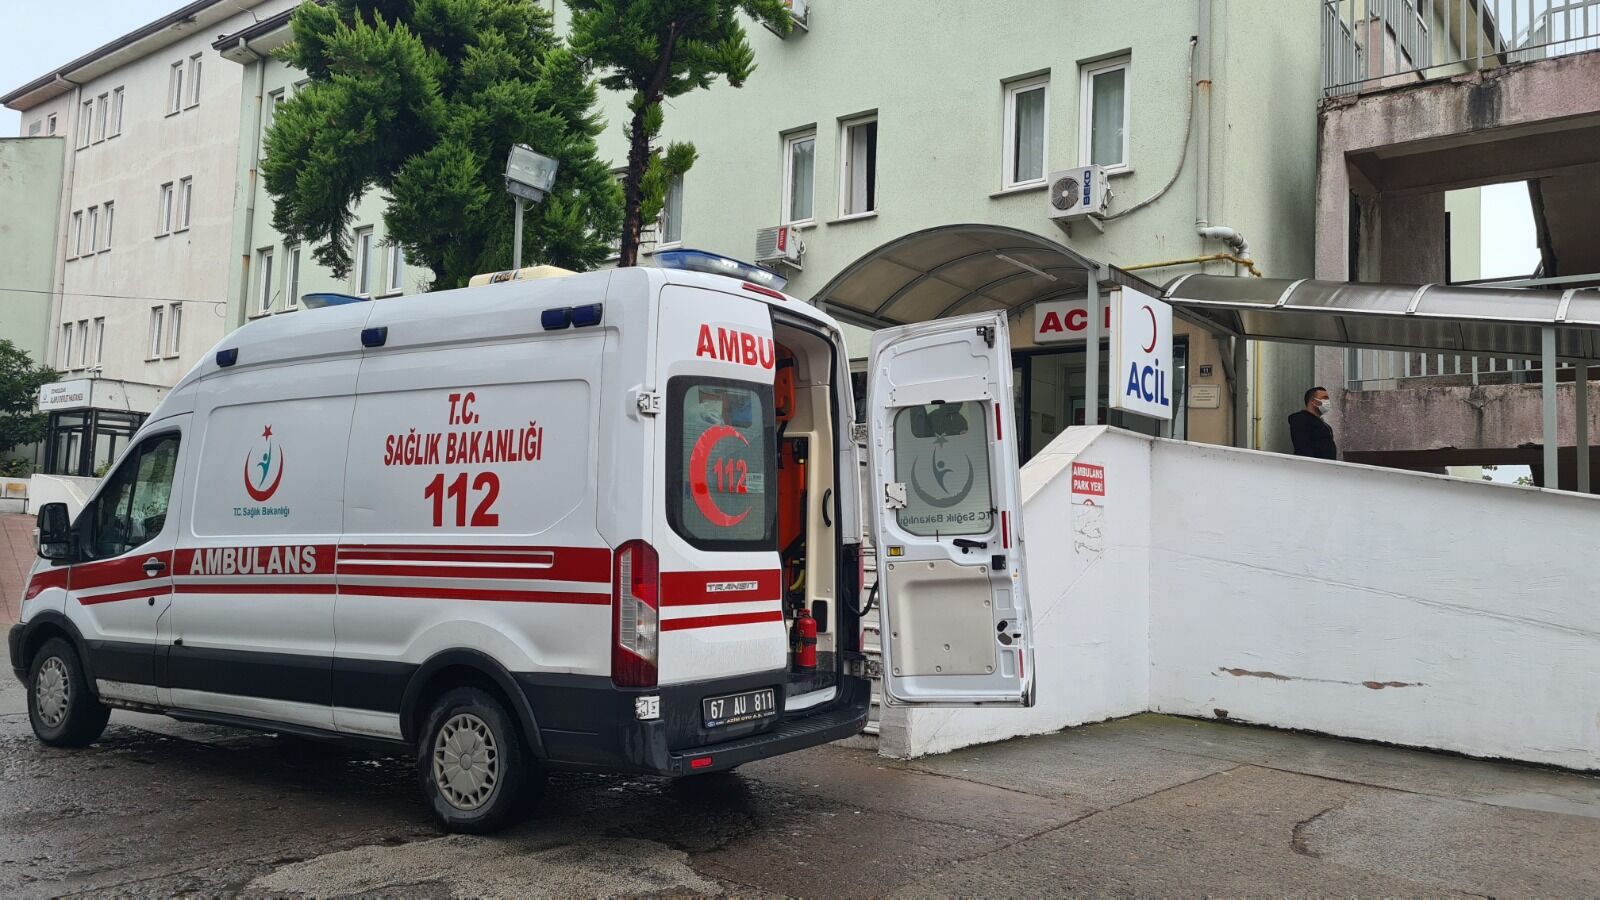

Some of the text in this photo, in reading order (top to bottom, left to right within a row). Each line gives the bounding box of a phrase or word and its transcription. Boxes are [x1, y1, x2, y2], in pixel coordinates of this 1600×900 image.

[1083, 170, 1091, 206] BEKO
[696, 324, 774, 369] AMBU
[1126, 358, 1169, 407] ACİL
[448, 392, 479, 425] T.C.
[384, 420, 543, 466] SAĞLIK BAKANLIĞI
[713, 458, 747, 494] 112
[1073, 466, 1103, 479] AMBULANS
[1073, 480, 1089, 491] PARK
[243, 507, 260, 518] Sağlık
[262, 506, 290, 518] Bakanlığı
[424, 471, 500, 527] 112
[189, 546, 317, 575] AMBULANS
[708, 582, 756, 592] TRANSIT
[710, 691, 772, 719] 67 AU 811
